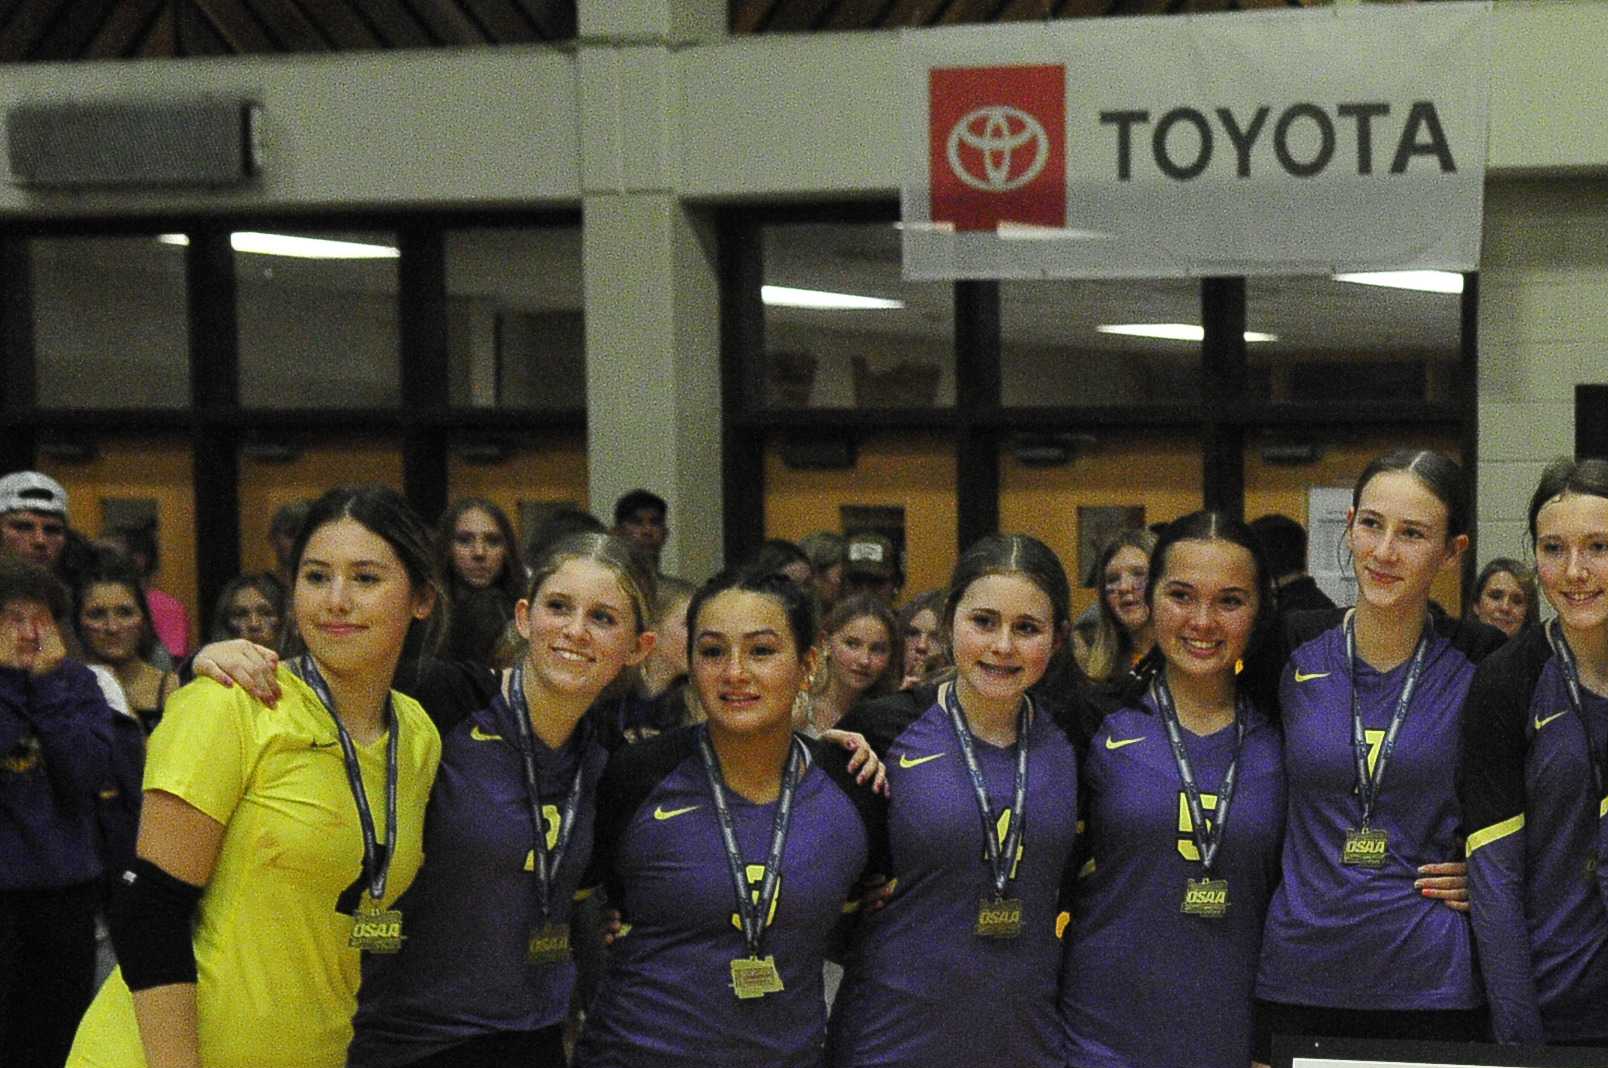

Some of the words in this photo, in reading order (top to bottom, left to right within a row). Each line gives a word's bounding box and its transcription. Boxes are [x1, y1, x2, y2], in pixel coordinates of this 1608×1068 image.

[1100, 100, 1457, 181] TOYOTA
[1346, 840, 1385, 854] OSAA
[1186, 890, 1226, 904] OSAA
[979, 910, 1021, 925] OSAA
[352, 922, 401, 938] OSAA
